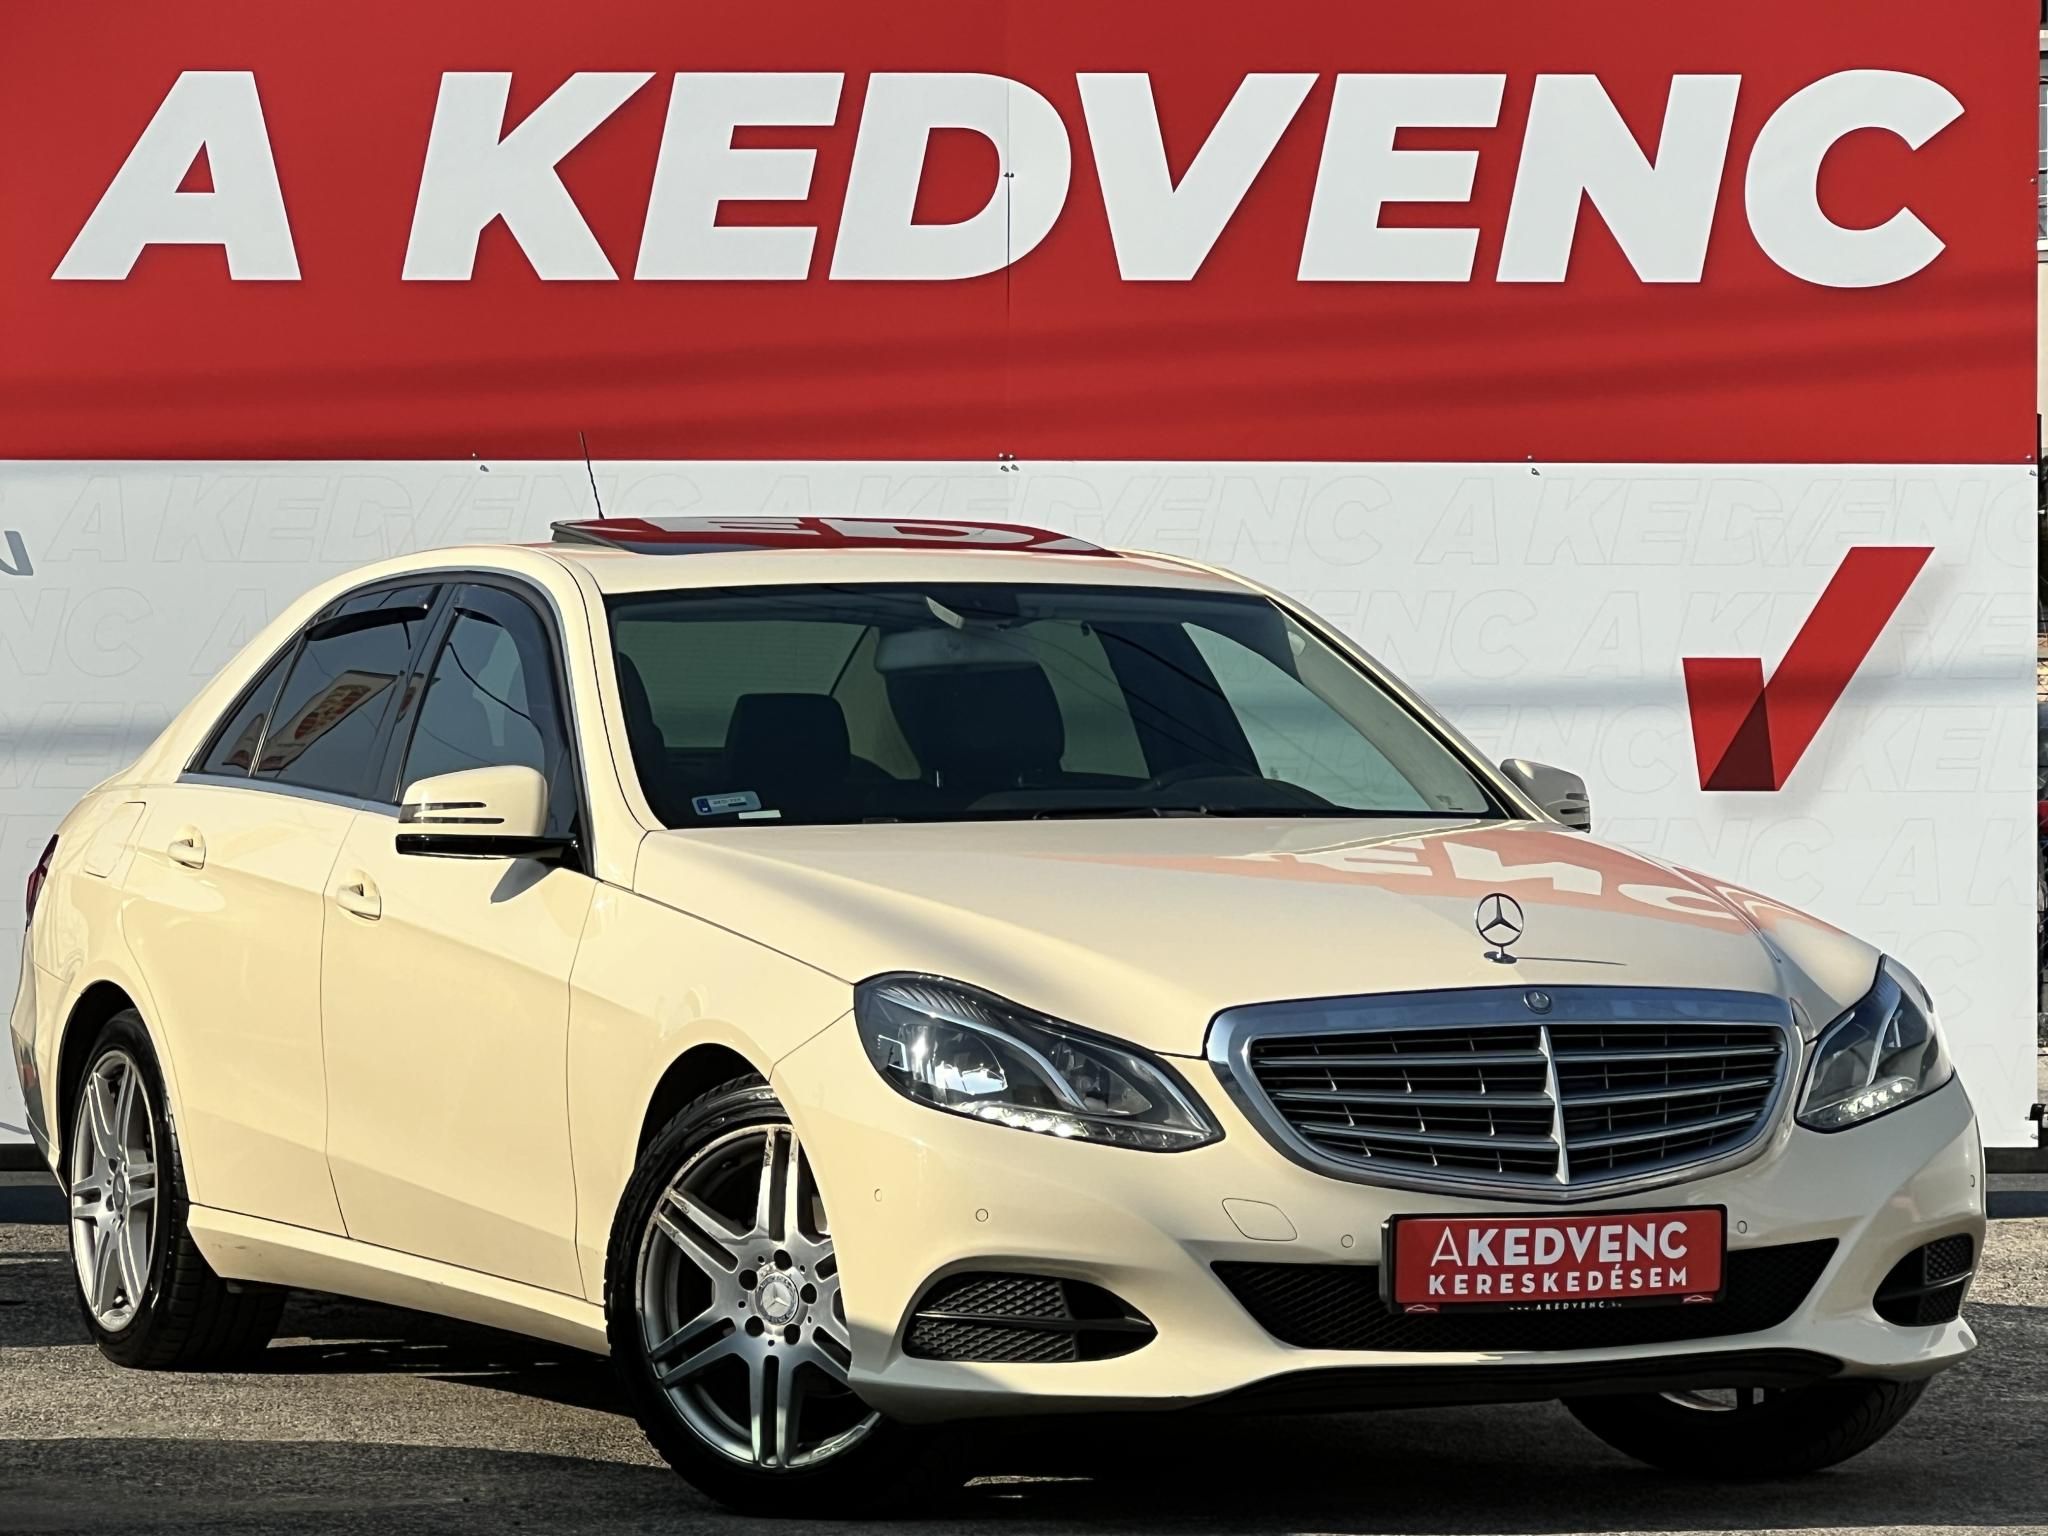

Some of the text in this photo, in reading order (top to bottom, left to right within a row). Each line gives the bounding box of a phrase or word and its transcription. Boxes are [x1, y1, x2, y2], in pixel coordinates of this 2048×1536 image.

[52, 69, 1964, 288] A KEDVENC
[1428, 1263, 1688, 1296] KERESKEDÉSEM
